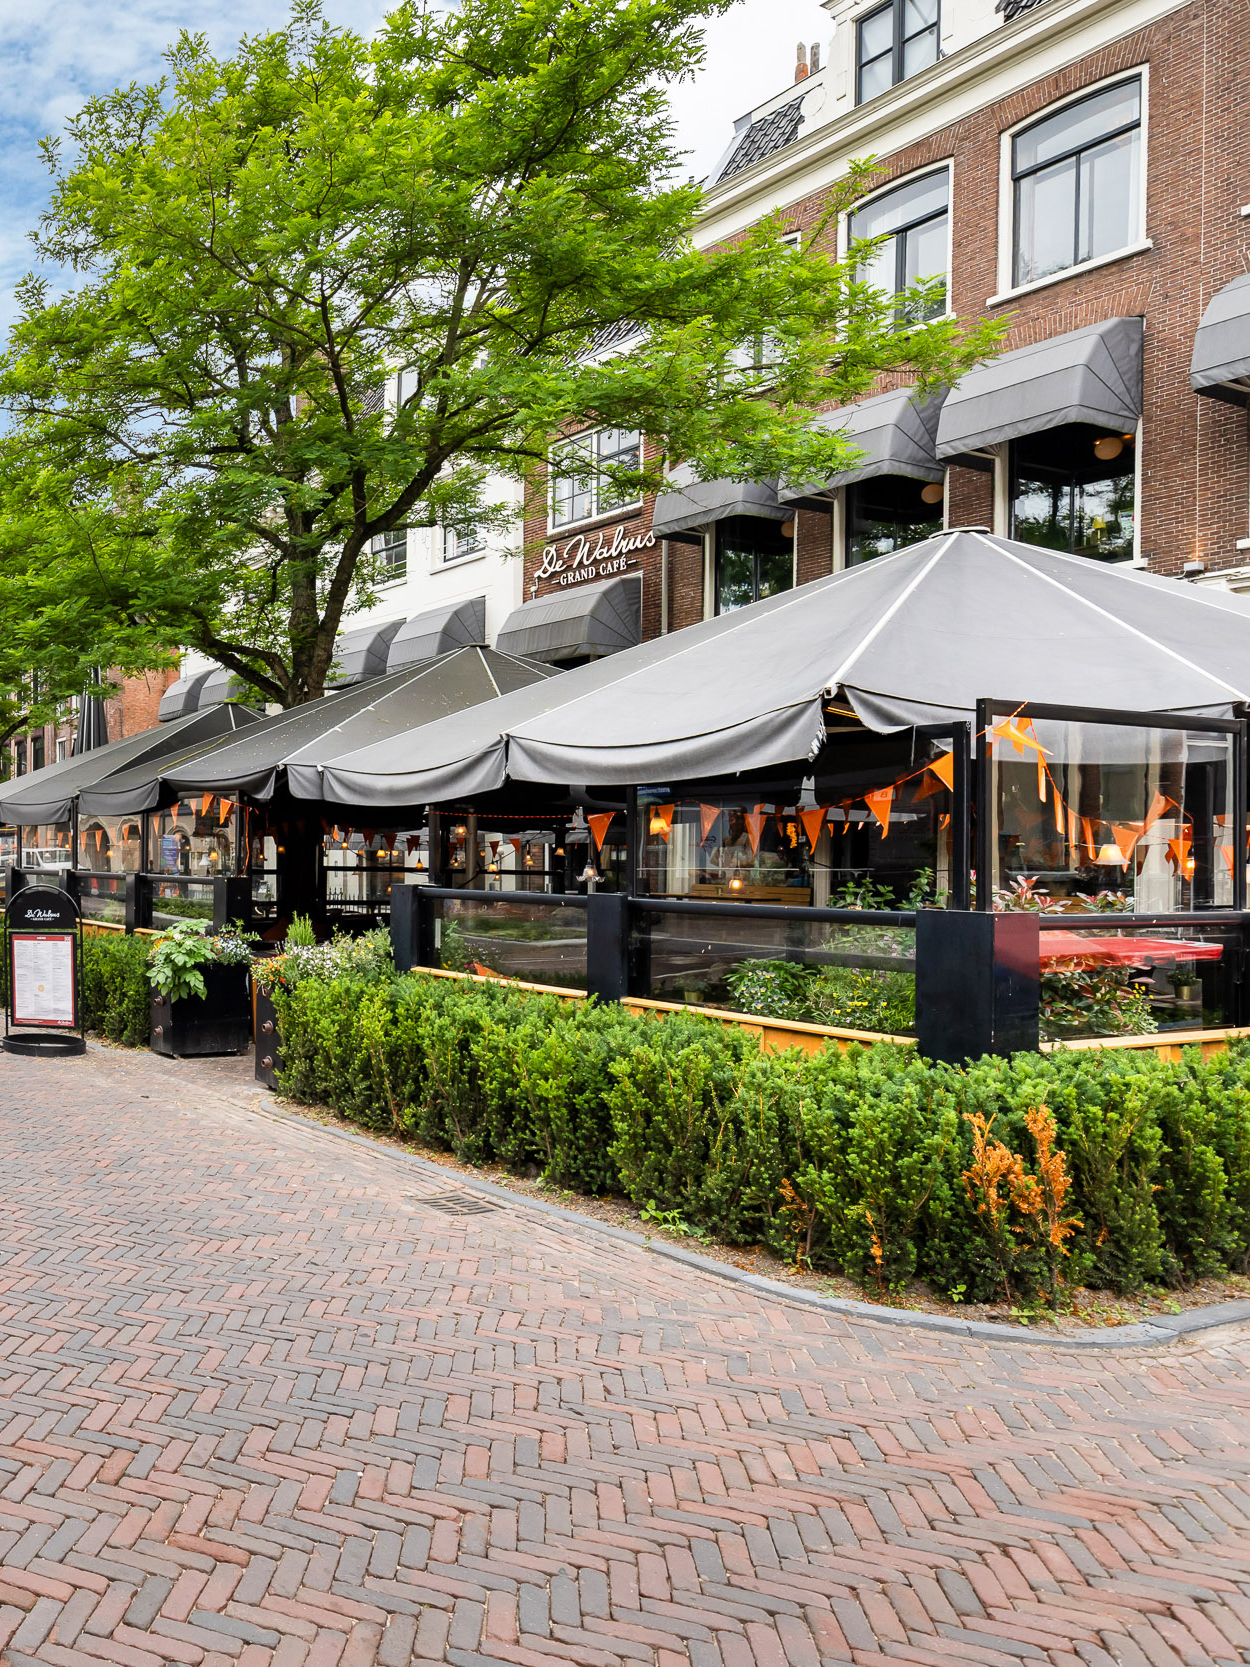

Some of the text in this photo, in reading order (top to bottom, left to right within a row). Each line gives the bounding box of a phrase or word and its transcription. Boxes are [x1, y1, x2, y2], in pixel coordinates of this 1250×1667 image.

[534, 526, 656, 578] De Walrus
[560, 554, 627, 586] GRAND CAFÉ
